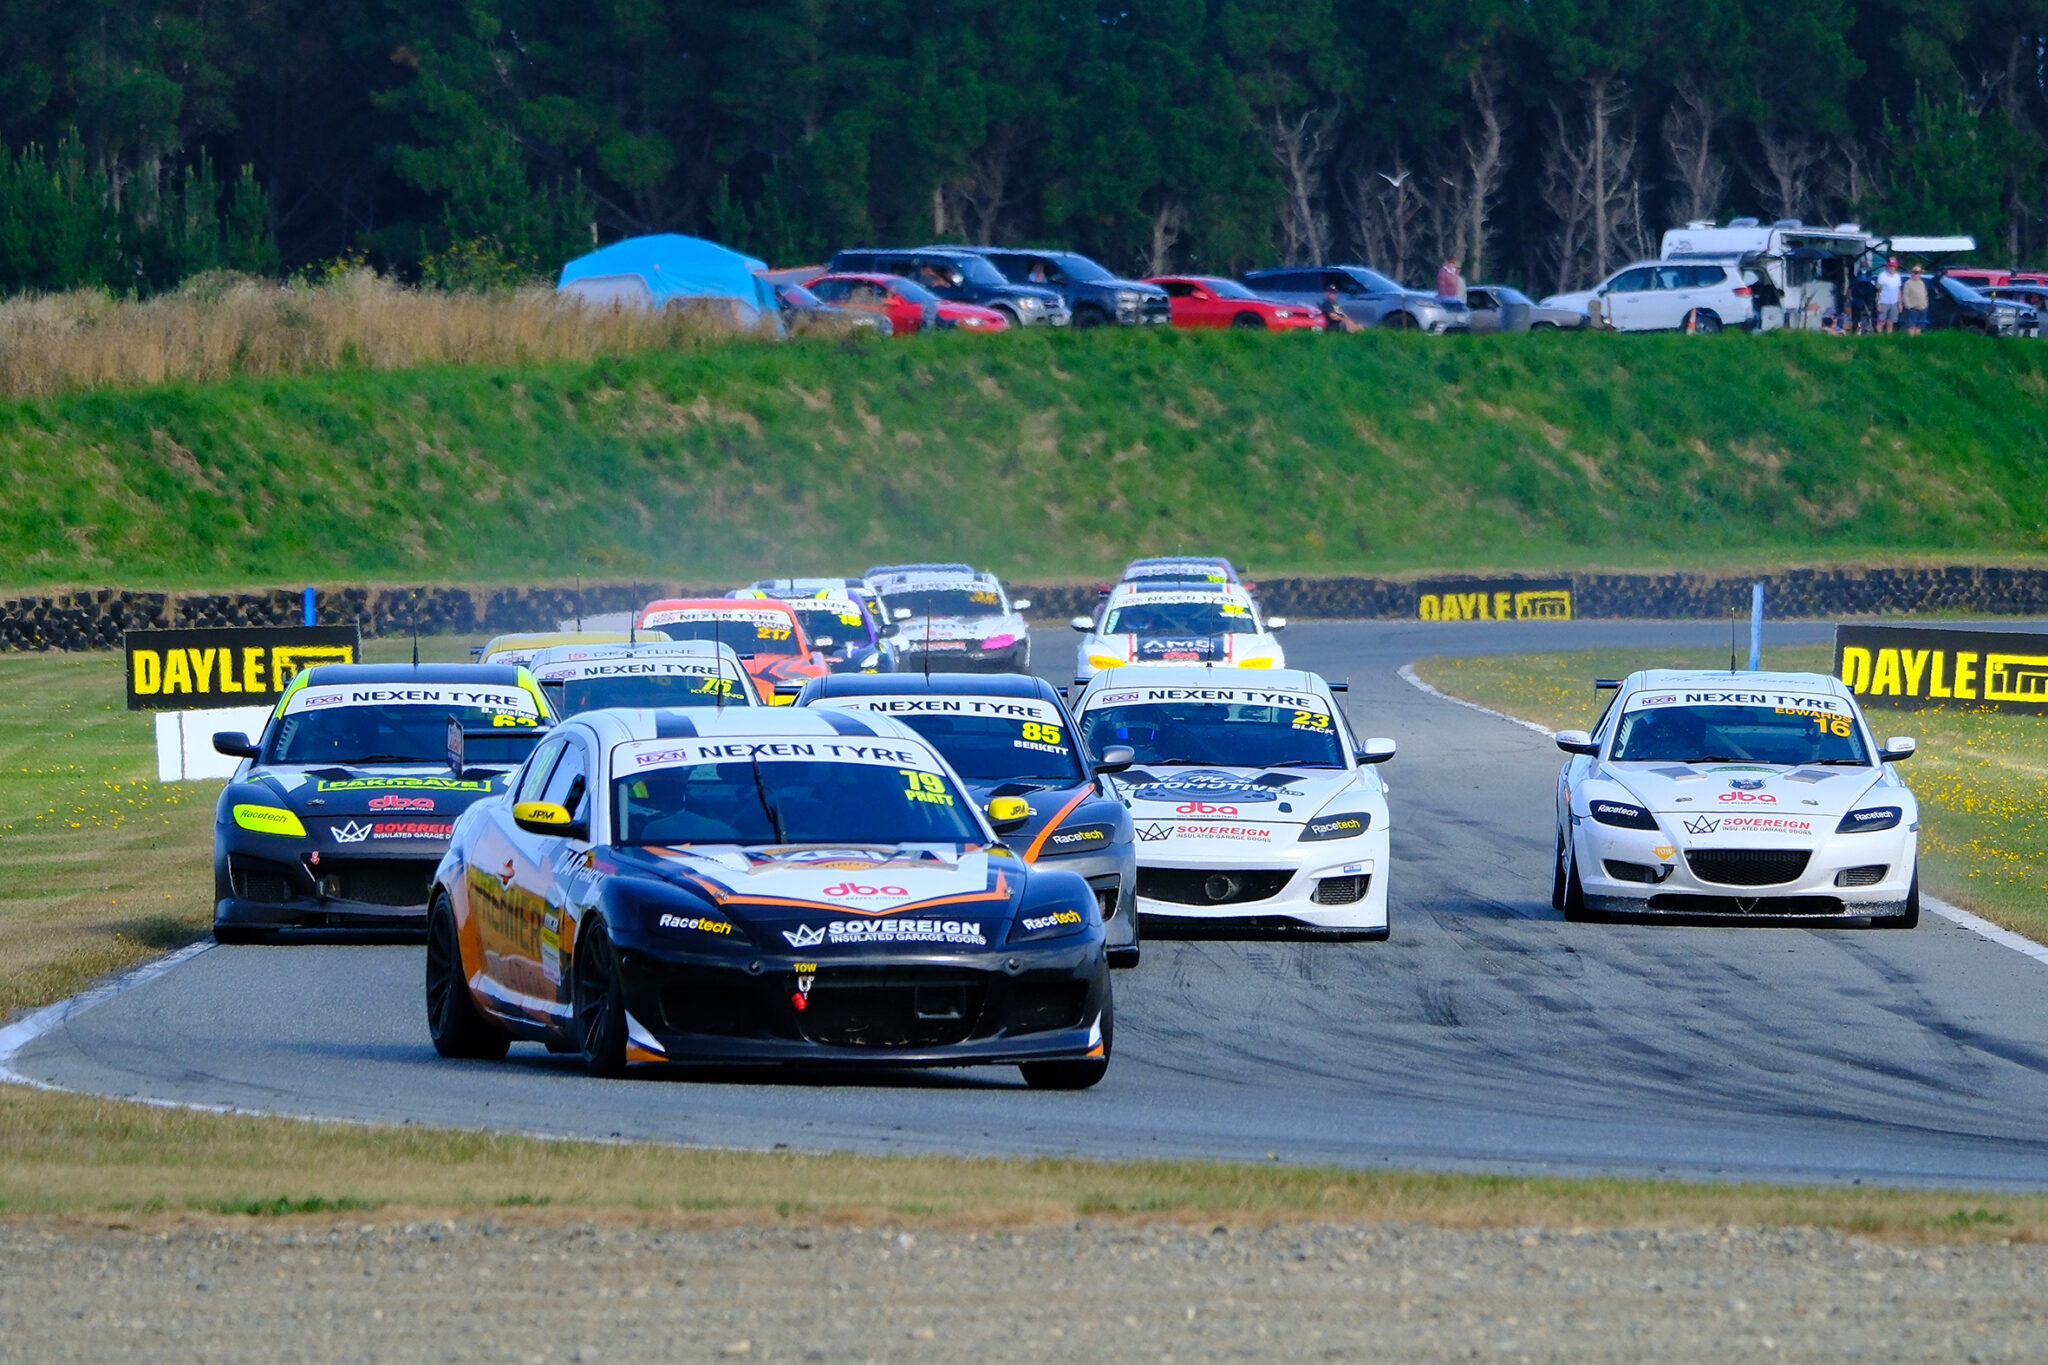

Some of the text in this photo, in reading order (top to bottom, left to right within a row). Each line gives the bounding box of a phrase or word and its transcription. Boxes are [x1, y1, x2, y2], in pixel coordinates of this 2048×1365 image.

[679, 612, 732, 620] NEXEN
[737, 612, 779, 622] TYRE
[757, 627, 792, 641] 217
[133, 647, 266, 695] DAYLE
[584, 663, 720, 676] NEXEN TYRE
[1842, 646, 1978, 699] DAYLE
[701, 677, 733, 693] 76
[353, 690, 519, 707] NEXEN TYRE
[690, 688, 744, 701] KITCING
[1149, 689, 1311, 709] NEXEN TYRE
[1685, 692, 1838, 711] NEXEN TYRE
[495, 707, 539, 721] Walker
[869, 700, 963, 713] NEXEN
[968, 701, 1043, 719] TYRE
[1774, 706, 1854, 723] EDWARDS
[1292, 711, 1330, 728] 23
[1022, 722, 1062, 745] 85
[1291, 723, 1336, 736] BLACK
[1813, 717, 1852, 738] 16
[700, 743, 917, 765] NEXEN TYRE
[1013, 739, 1069, 756] BERKETT
[899, 769, 947, 795] 79
[368, 795, 435, 809] dba
[904, 790, 954, 807] PRATT
[1718, 791, 1777, 803] dba
[528, 809, 555, 820] JPM
[1010, 804, 1026, 816] JPM
[1175, 801, 1239, 815] dba
[1597, 804, 1639, 817] Racetech
[1854, 809, 1895, 822] Racetech
[240, 809, 288, 823] Racetech
[1723, 818, 1811, 829] SOVEREIGN
[1176, 825, 1271, 837] SOVEREIGN
[1310, 818, 1361, 835] Racetech
[1051, 829, 1105, 846] Racetech
[1215, 834, 1246, 842] GARAGE
[1246, 835, 1272, 843] DOORS
[822, 883, 909, 897] dba
[659, 913, 733, 935] Racetech
[828, 919, 982, 936] SOVEREIGN
[1021, 909, 1082, 931] Racetech
[830, 933, 987, 946] INSULATED GARAGE DOORS
[793, 962, 817, 974] TOW
